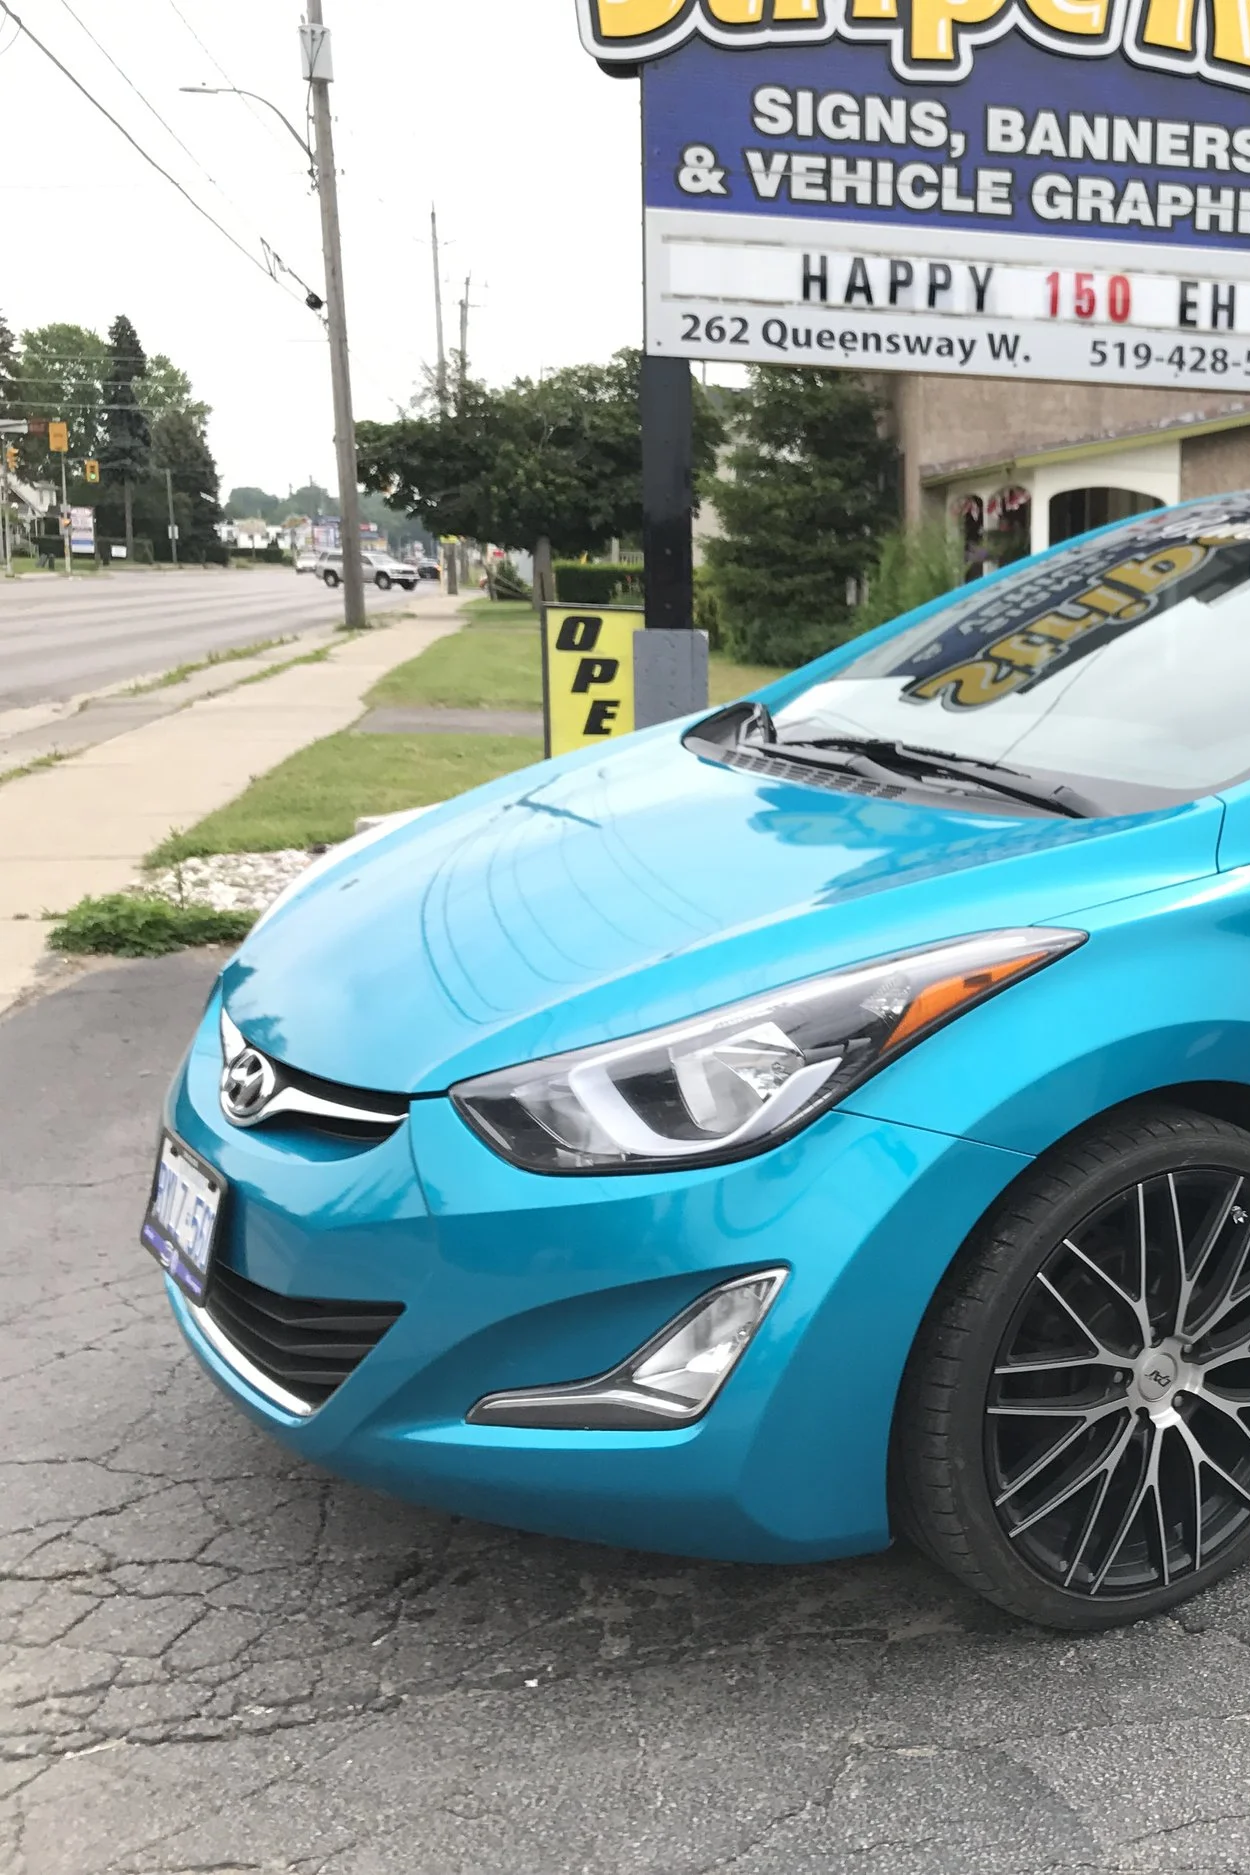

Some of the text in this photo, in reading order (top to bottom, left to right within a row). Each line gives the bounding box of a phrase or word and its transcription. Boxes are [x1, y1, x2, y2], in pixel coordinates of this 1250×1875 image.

[752, 87, 966, 158] SIGNS,
[678, 145, 728, 195] &
[745, 151, 1014, 216] VEHICLE
[802, 253, 1236, 331] HAPPY 150 EH
[680, 313, 751, 346] 262
[761, 317, 977, 367] Queensway
[986, 332, 1031, 363] W.
[555, 615, 621, 736] OPE
